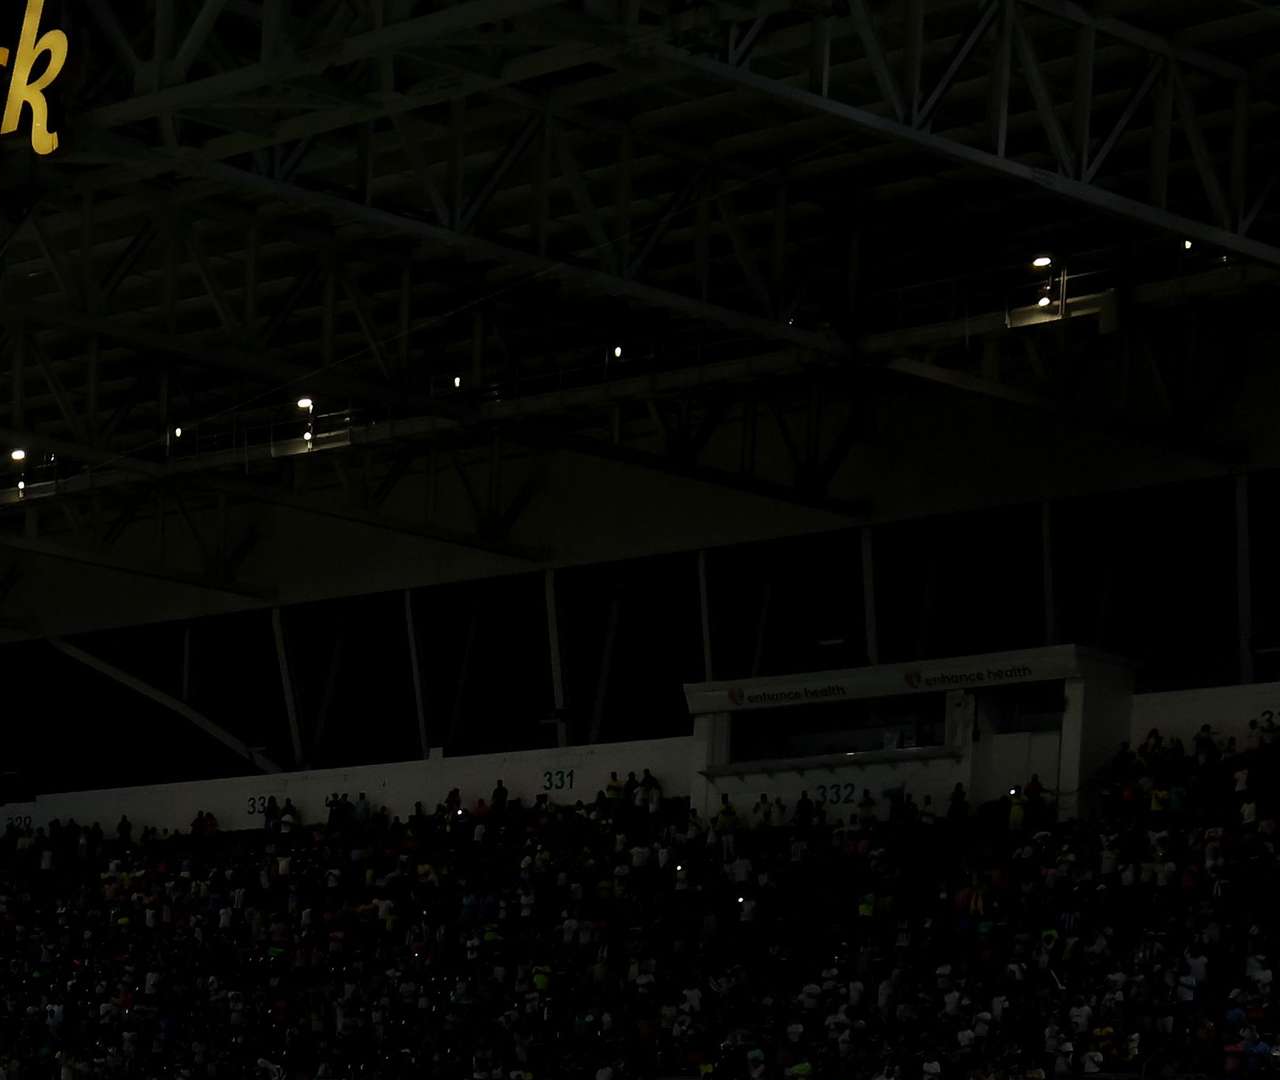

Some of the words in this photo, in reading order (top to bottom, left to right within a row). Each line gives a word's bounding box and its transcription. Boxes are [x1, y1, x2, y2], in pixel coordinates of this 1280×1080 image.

[926, 670, 984, 686] enhance
[987, 665, 1032, 681] health
[747, 690, 801, 703] enhance
[804, 685, 847, 698] health
[544, 769, 574, 790] 331
